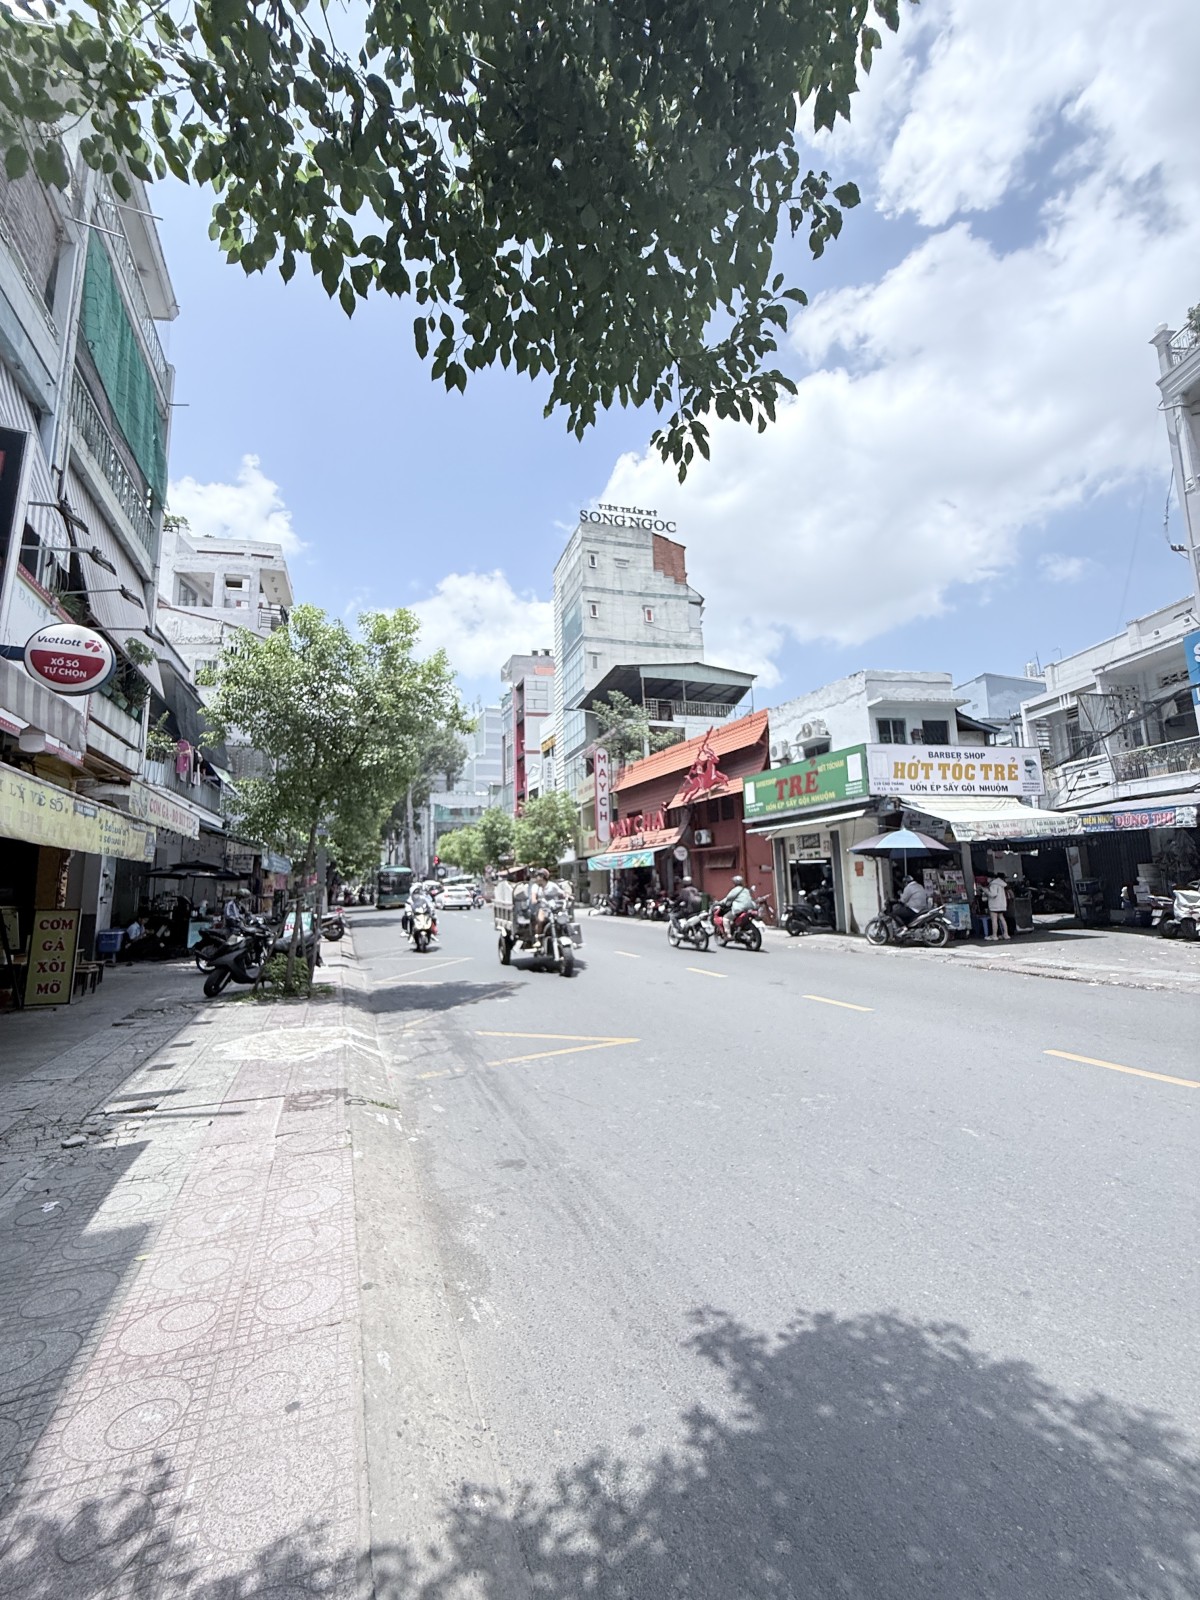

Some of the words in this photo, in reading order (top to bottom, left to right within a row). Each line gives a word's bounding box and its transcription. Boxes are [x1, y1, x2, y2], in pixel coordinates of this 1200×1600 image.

[580, 509, 625, 528] SONG
[37, 635, 82, 647] Vietlott
[59, 668, 87, 679] CHỌN
[928, 751, 962, 760] BARBER
[963, 752, 986, 760] SHOP
[893, 755, 934, 780] HỚT
[937, 758, 976, 781] TÓC
[980, 756, 1019, 781] TRẺ
[910, 781, 928, 792] UỐN
[930, 782, 942, 792] ÉP
[943, 781, 959, 792] SẤY
[961, 783, 976, 793] GỘI
[979, 783, 1009, 794] NHUỘM
[39, 917, 74, 930] CƠM
[36, 956, 66, 973] XỐI
